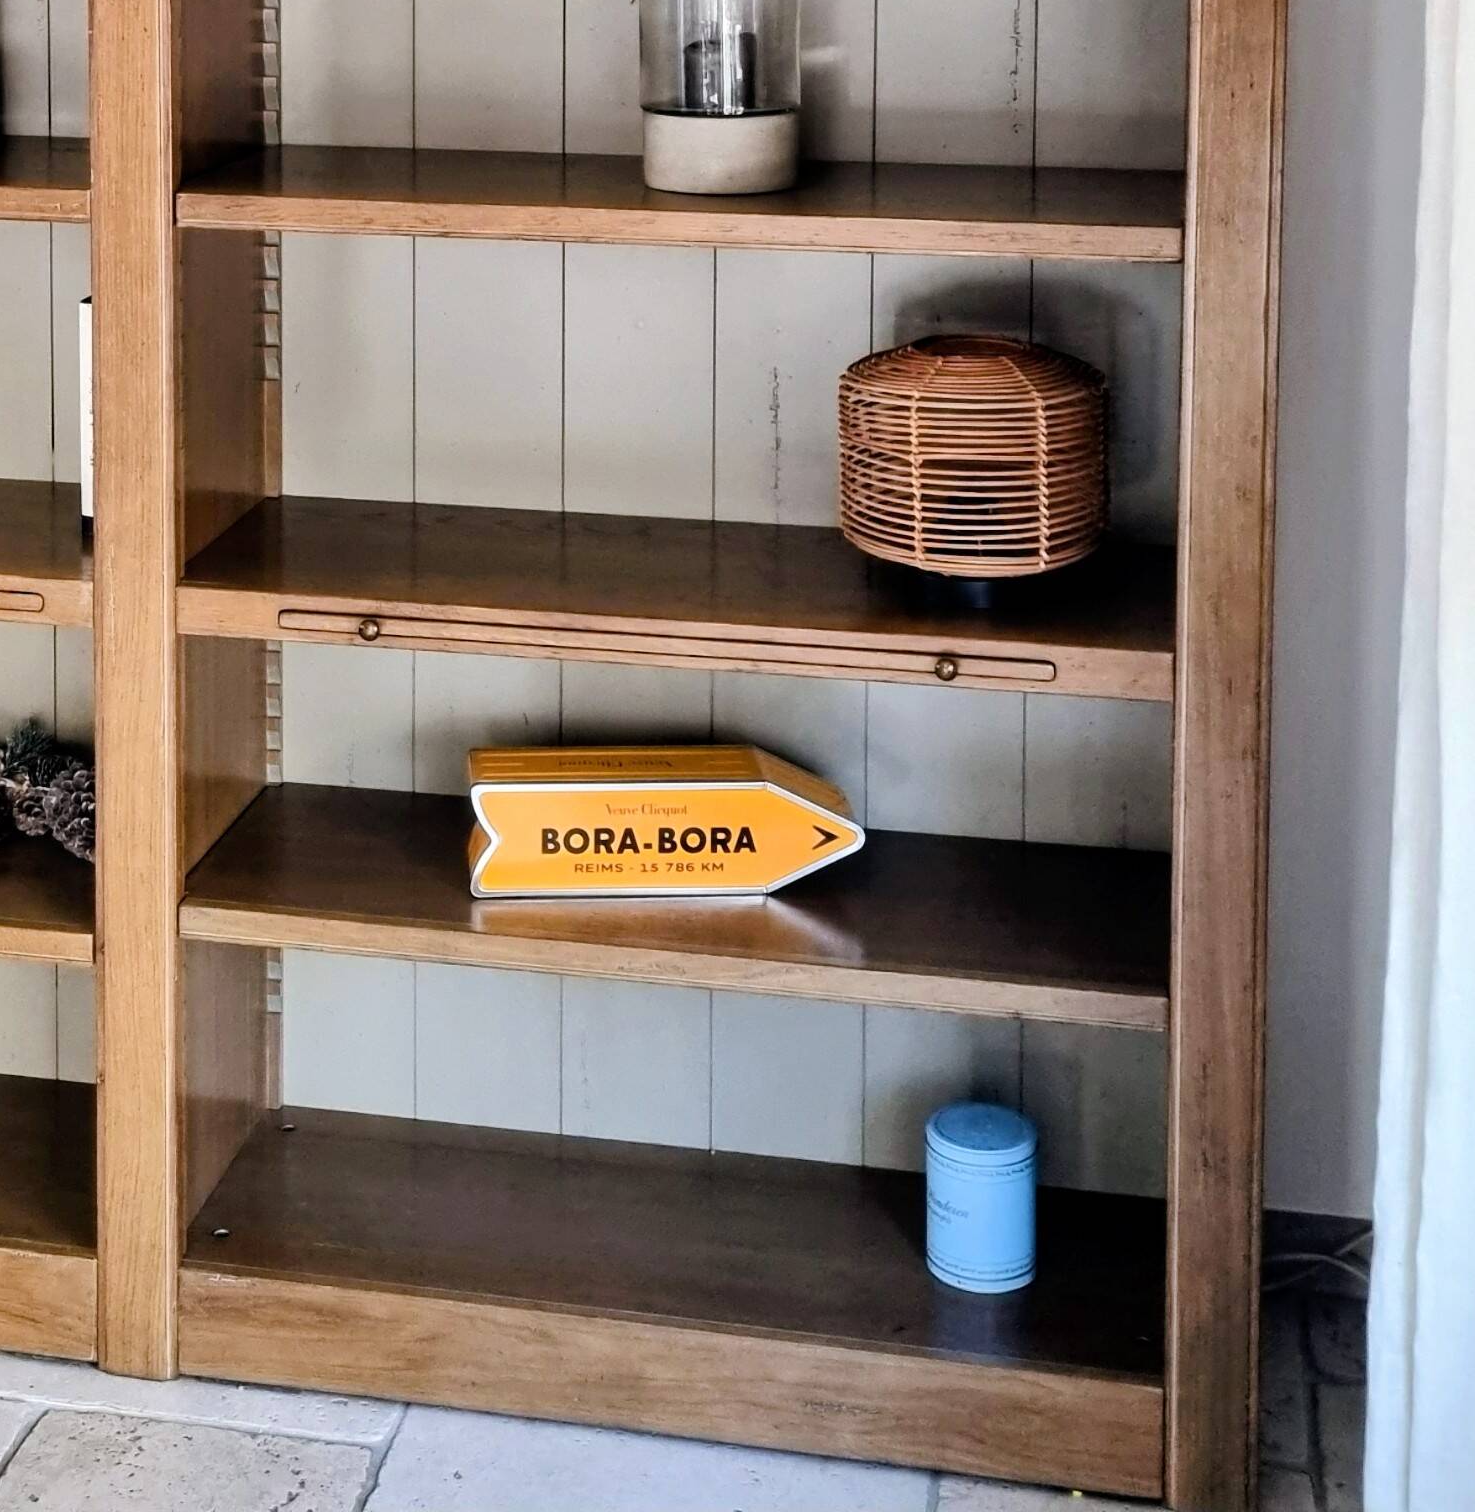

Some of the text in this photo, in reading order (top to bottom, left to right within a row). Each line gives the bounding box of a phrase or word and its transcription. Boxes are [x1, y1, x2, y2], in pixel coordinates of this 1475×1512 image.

[605, 803, 688, 817] Veuve Clicquot
[541, 826, 757, 855] BORA-BORA
[574, 863, 624, 873] REIMS
[640, 863, 659, 872] 15
[666, 862, 695, 872] 786
[701, 862, 725, 872] KM
